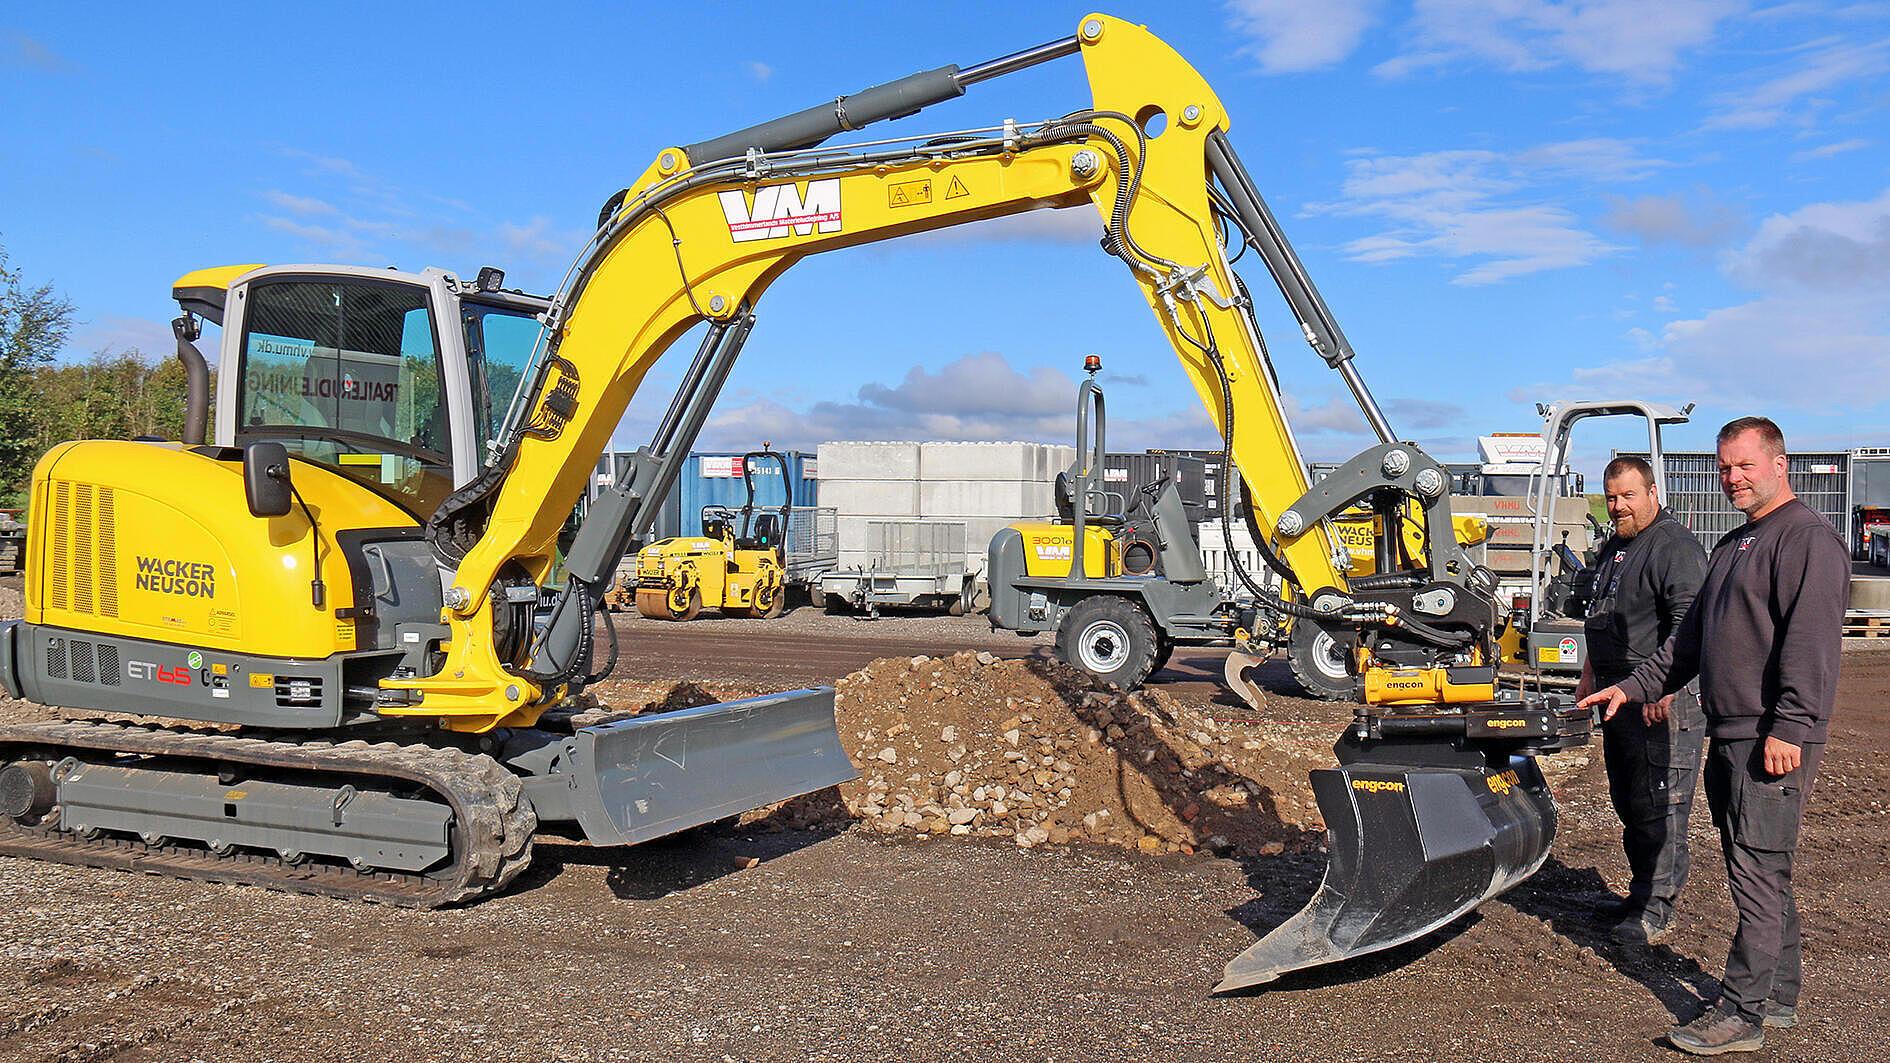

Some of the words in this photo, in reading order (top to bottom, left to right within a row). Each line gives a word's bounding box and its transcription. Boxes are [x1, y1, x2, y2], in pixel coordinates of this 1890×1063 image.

[717, 177, 842, 243] VM
[136, 556, 215, 581] WACKER
[136, 574, 215, 599] NEUSON
[128, 660, 192, 687] ET65
[1386, 682, 1424, 690] engcon
[1487, 719, 1526, 729] engcon
[1352, 779, 1404, 793] engcon
[1487, 769, 1520, 796] engcon
